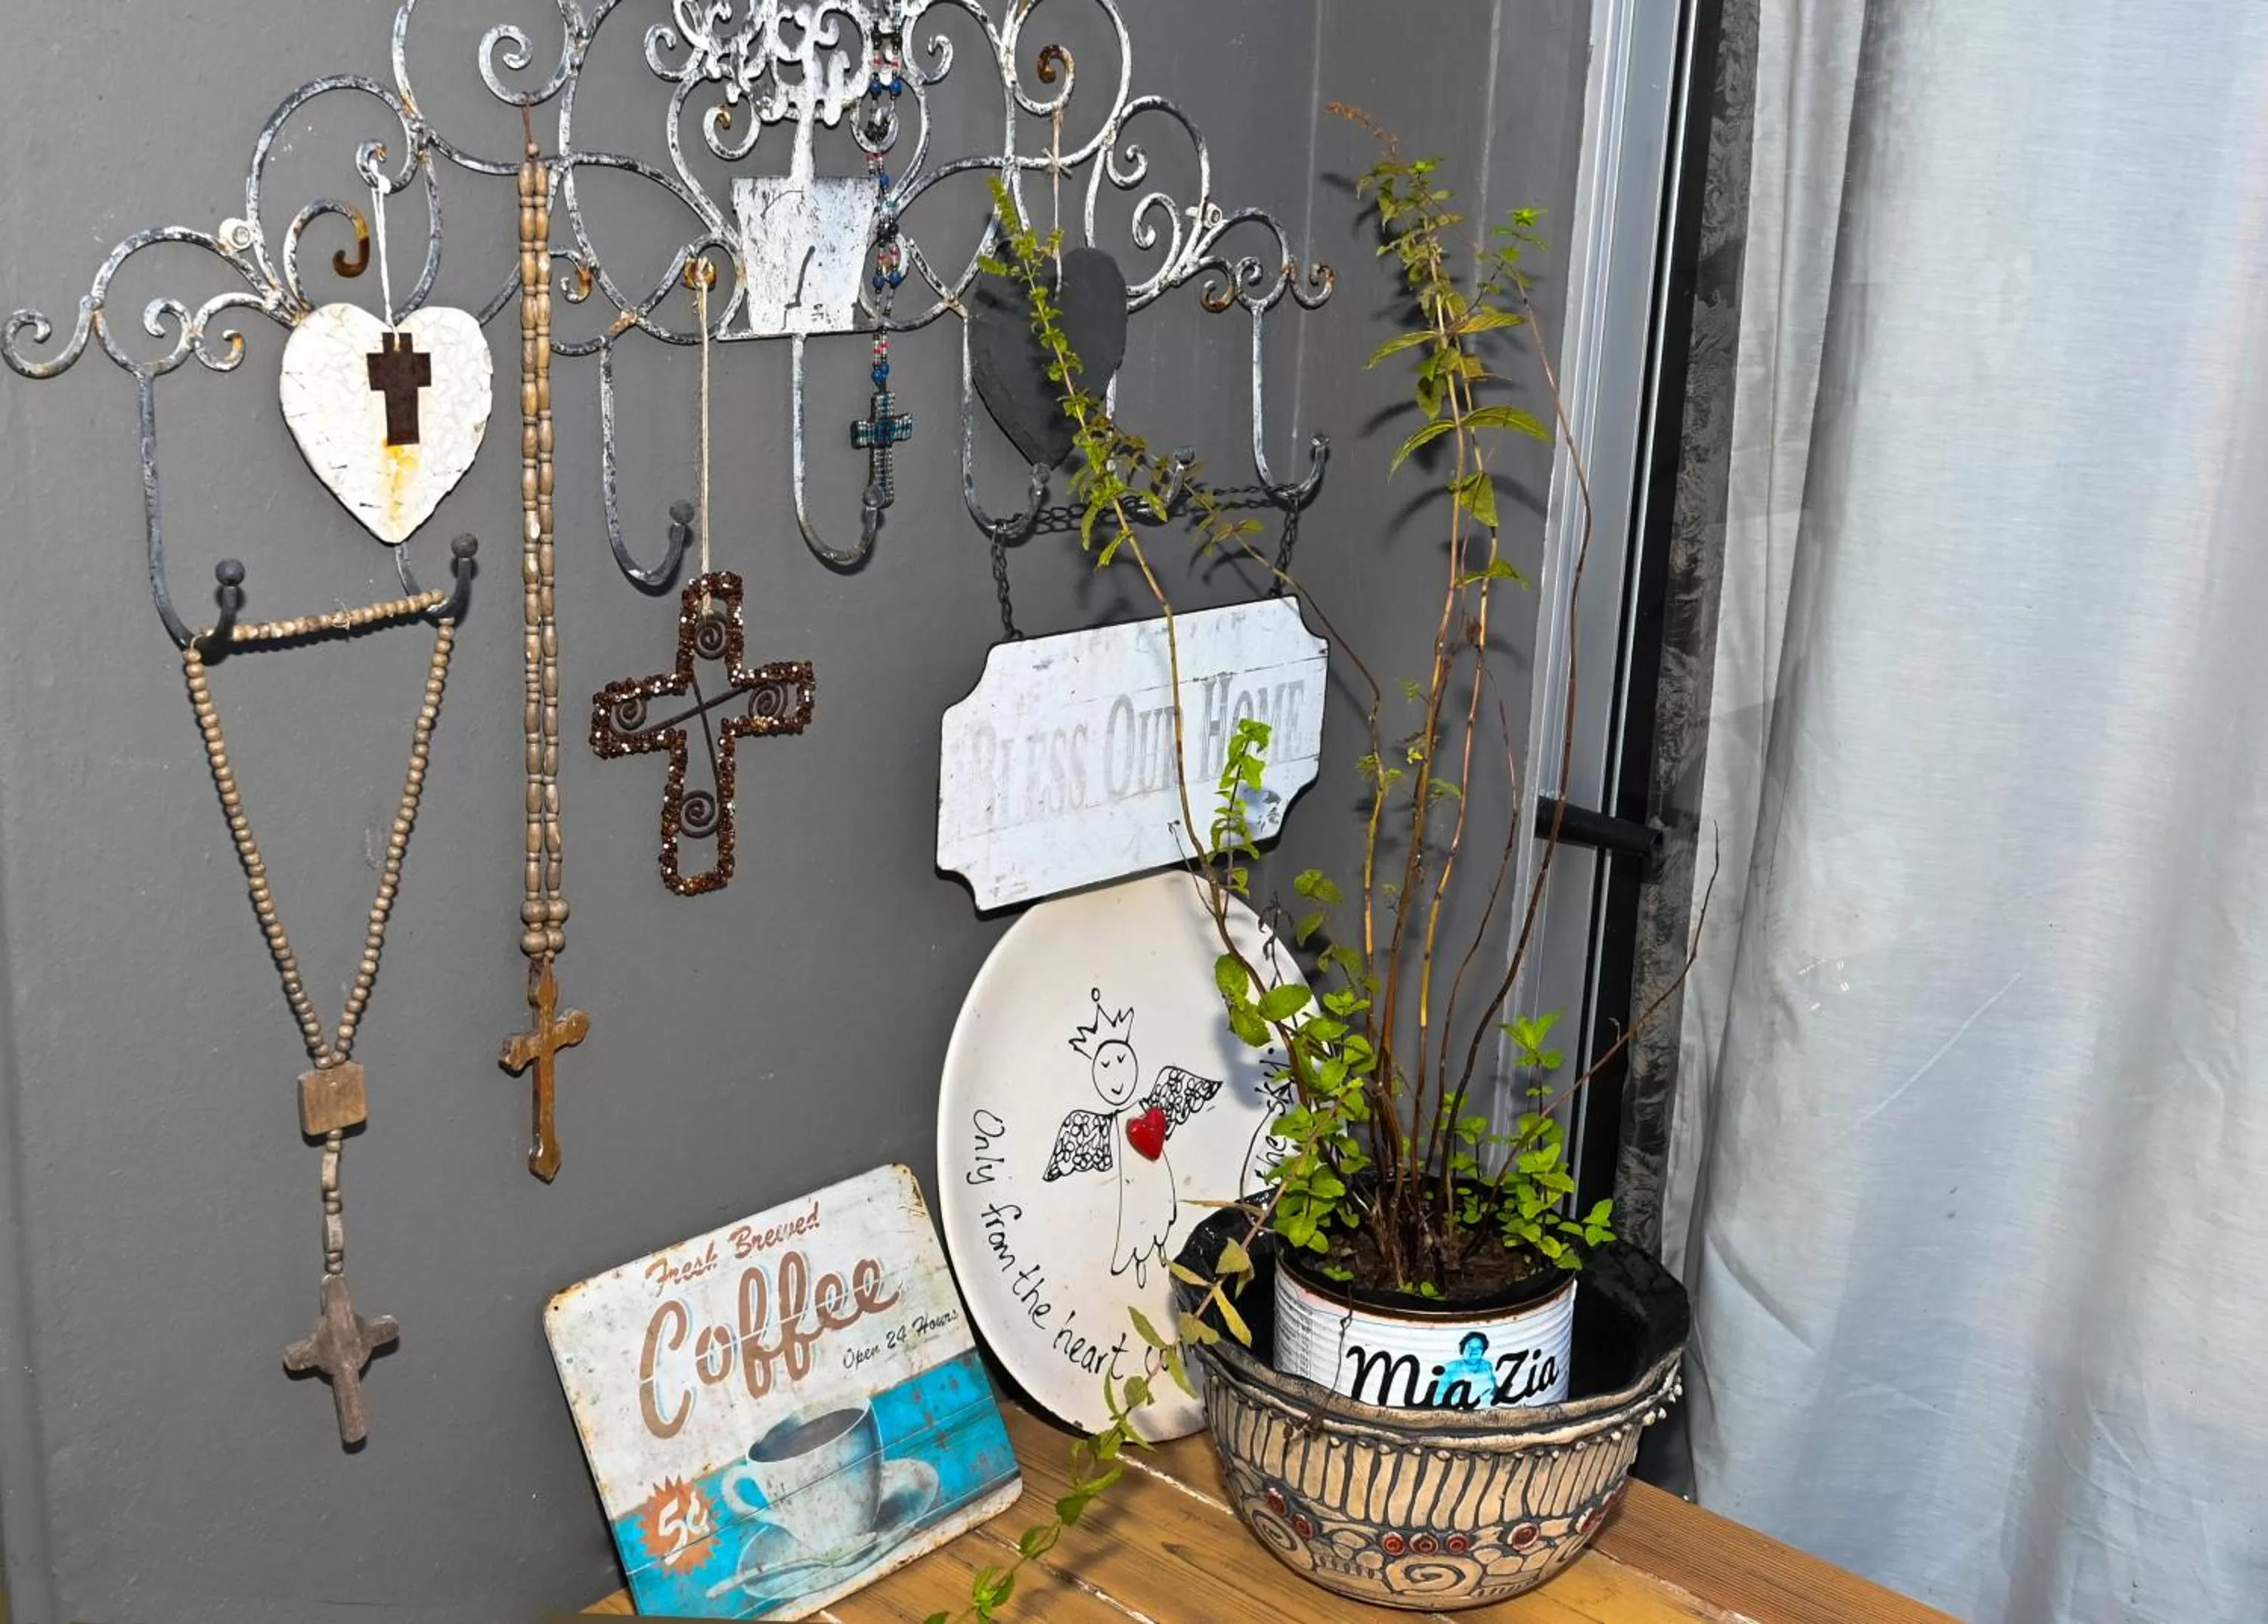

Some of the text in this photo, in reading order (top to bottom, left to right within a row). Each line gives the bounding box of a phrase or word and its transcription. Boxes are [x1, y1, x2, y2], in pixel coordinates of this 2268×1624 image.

[966, 1109, 1006, 1185] Only
[728, 1201, 820, 1259] Brewed
[981, 1203, 1022, 1272] from
[1012, 1264, 1052, 1330] the
[639, 1250, 903, 1438] Coffee
[843, 1309, 959, 1370] Open 24 Hours
[1053, 1310, 1130, 1380] heart
[1346, 1345, 1559, 1410] Mia Zia
